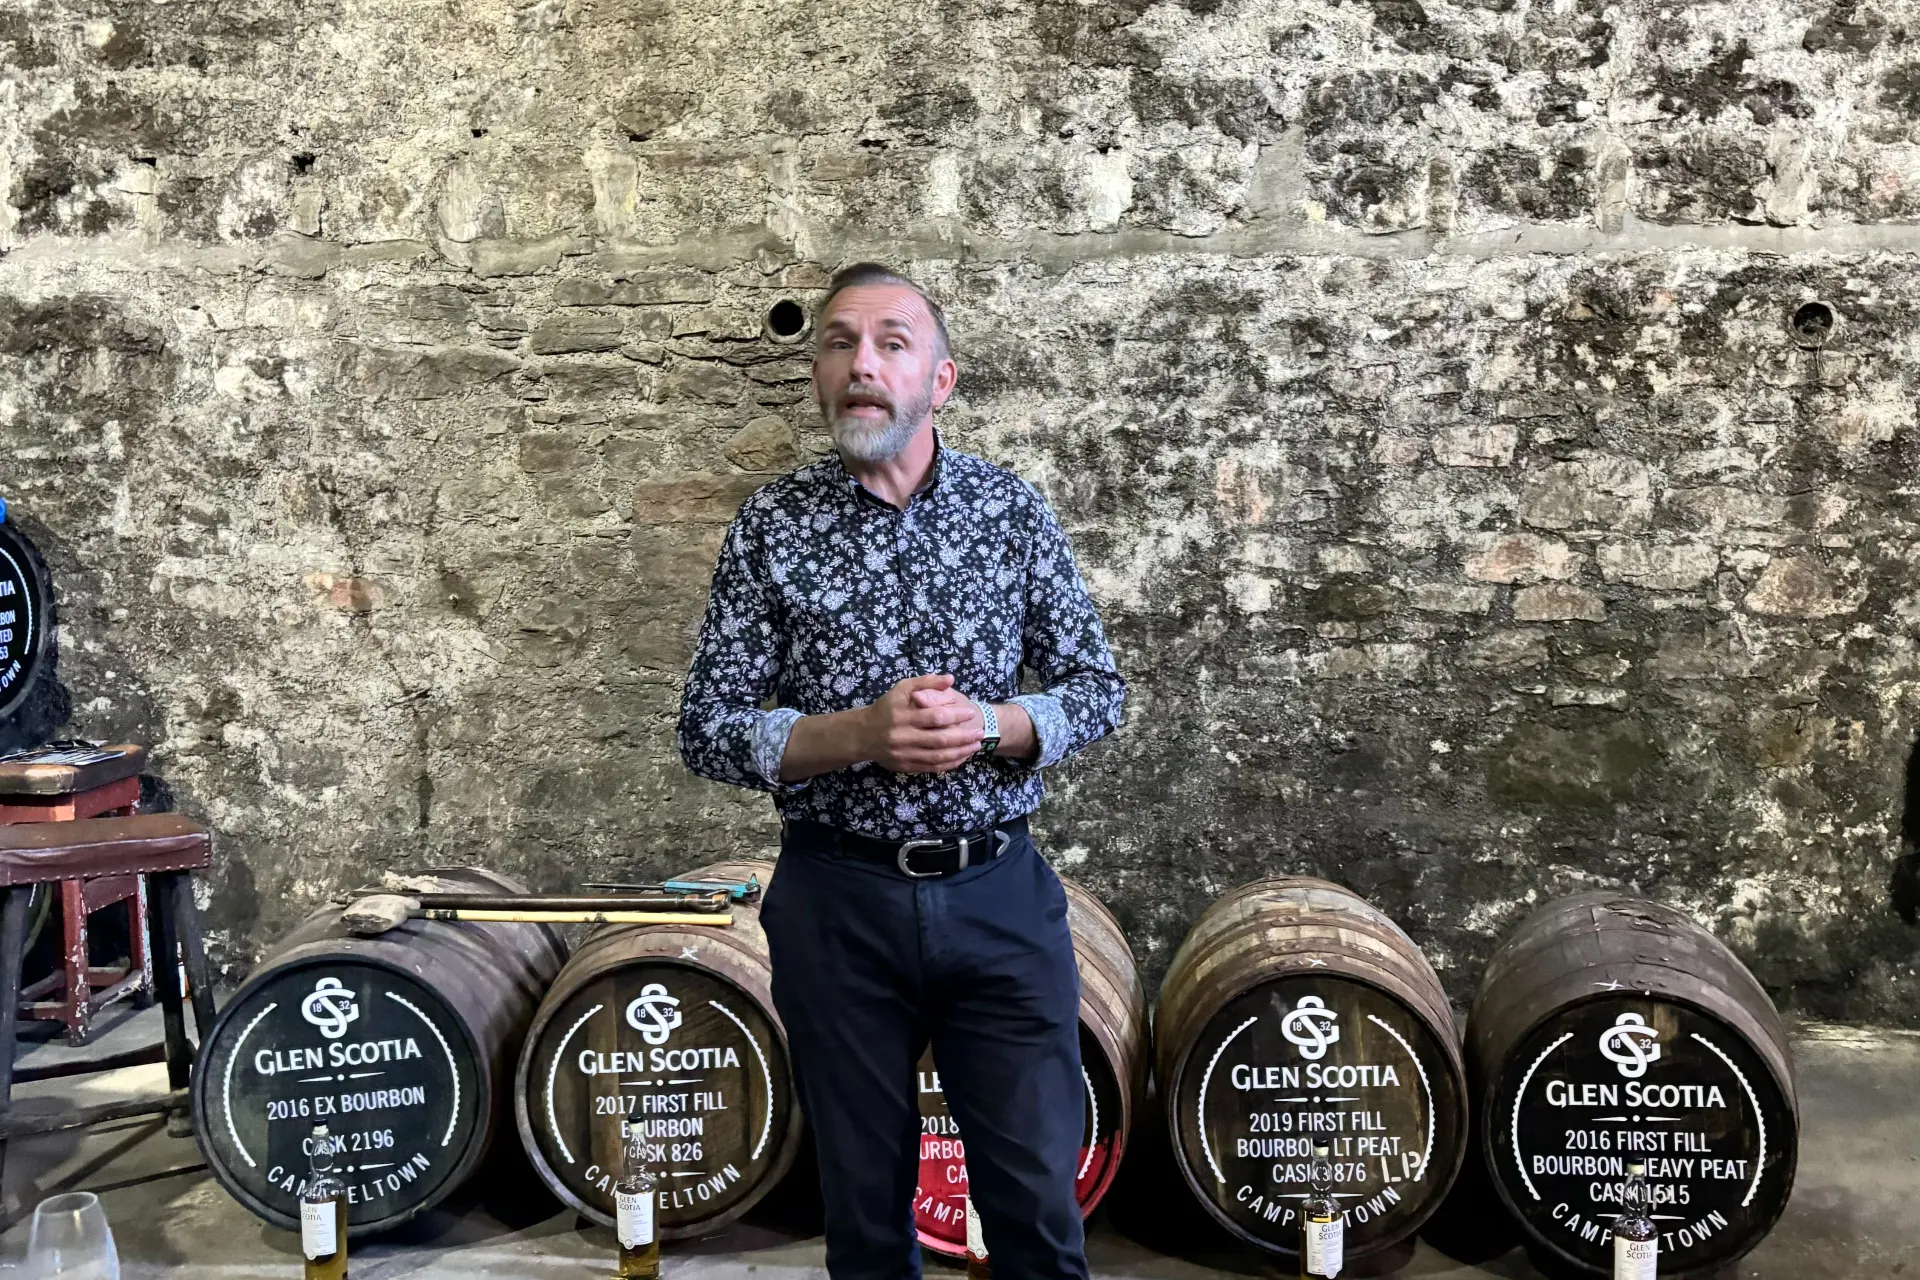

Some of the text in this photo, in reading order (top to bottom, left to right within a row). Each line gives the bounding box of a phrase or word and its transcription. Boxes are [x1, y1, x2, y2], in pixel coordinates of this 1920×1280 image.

[0, 660, 21, 691] OWN
[255, 1037, 423, 1076] GLEN SCOTIA
[578, 1047, 741, 1077] GLEN SCOTIA
[1231, 1063, 1400, 1092] GLEN SCOTIA
[266, 1086, 425, 1121] 2016 EX BOURBON
[595, 1091, 728, 1115] 2017 FIRST FILL
[1546, 1080, 1726, 1108] GLEN SCOTIA
[622, 1117, 703, 1138] BURBON
[1249, 1111, 1386, 1132] 2019 FIRST FILL
[352, 1129, 394, 1151] 2196
[919, 1140, 965, 1160] URBO
[1334, 1137, 1352, 1157] LT
[1358, 1136, 1401, 1156] PEAT
[1565, 1130, 1711, 1153] 2016 FIRST FILL
[671, 1142, 703, 1162] 826
[947, 1165, 969, 1183] CA
[1701, 1159, 1748, 1180] PEAT
